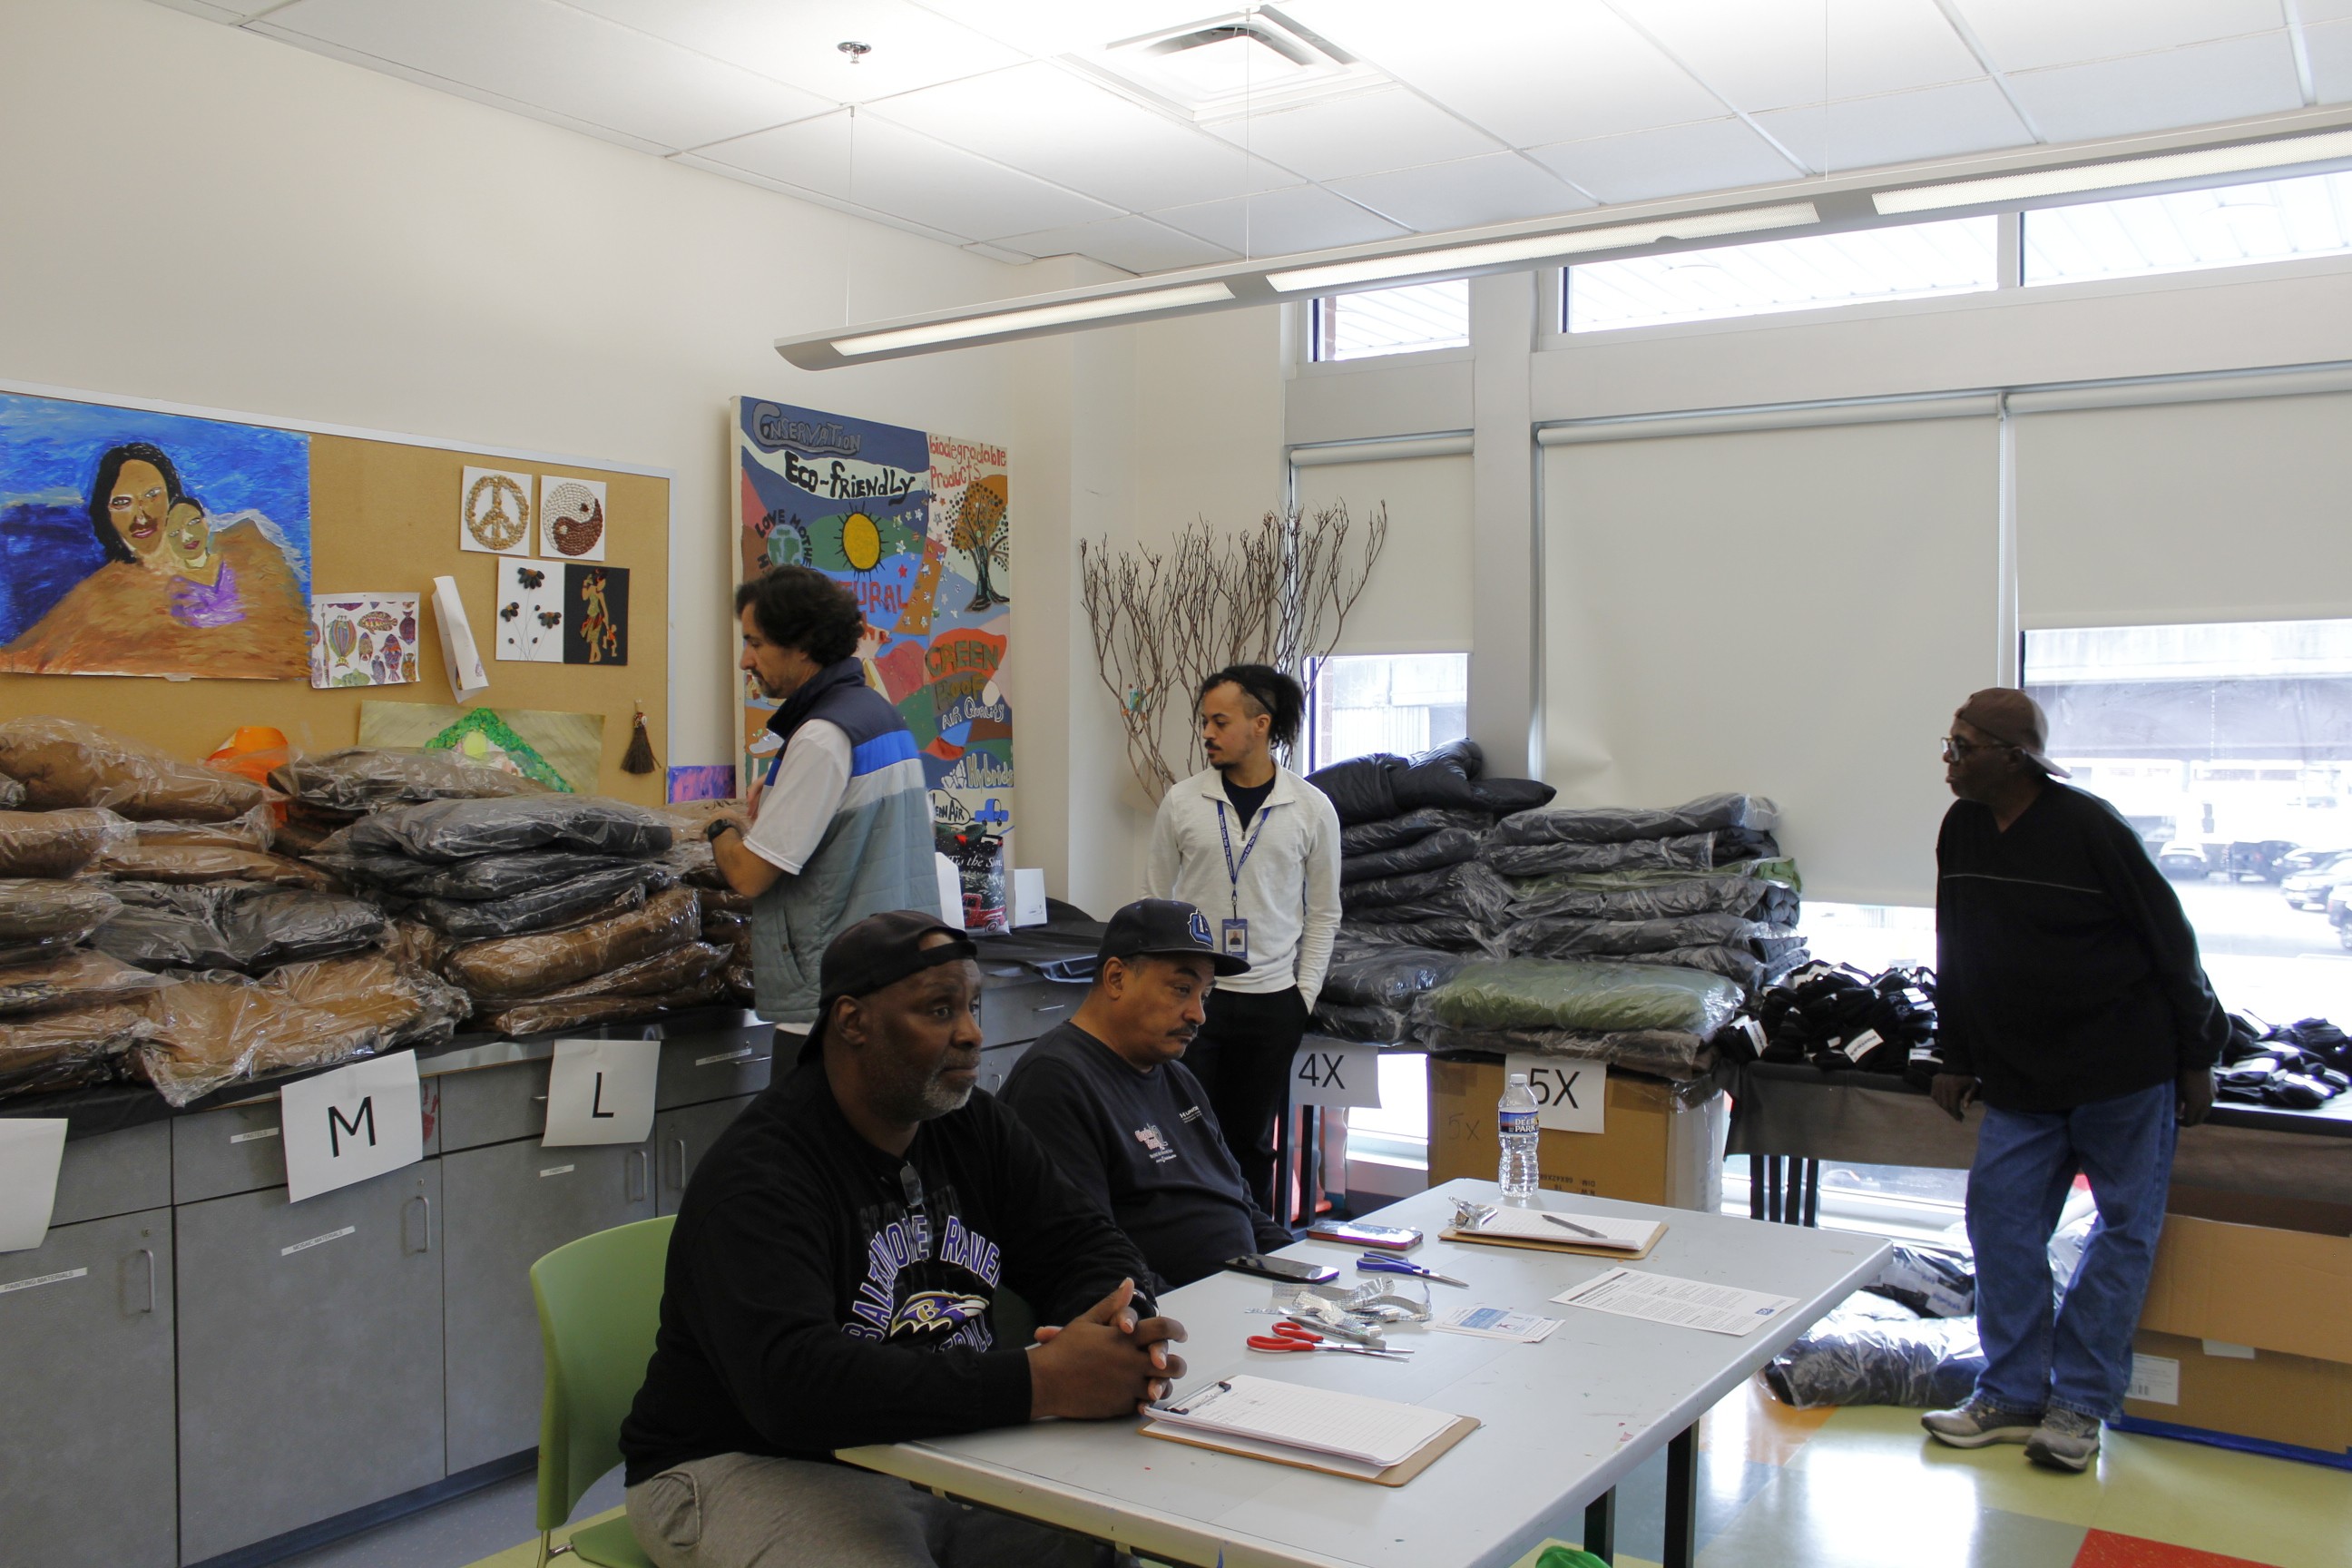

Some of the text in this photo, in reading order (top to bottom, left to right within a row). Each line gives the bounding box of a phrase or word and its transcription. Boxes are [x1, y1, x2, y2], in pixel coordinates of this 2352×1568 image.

[755, 509, 818, 571] LOVE MOTHE
[926, 640, 998, 677] GREEN
[966, 855, 984, 867] the
[1298, 1053, 1346, 1090] 4X
[1529, 1068, 1581, 1109] 5X
[593, 1072, 615, 1119] L
[328, 1095, 377, 1158] M
[1514, 1118, 1535, 1126] DEER
